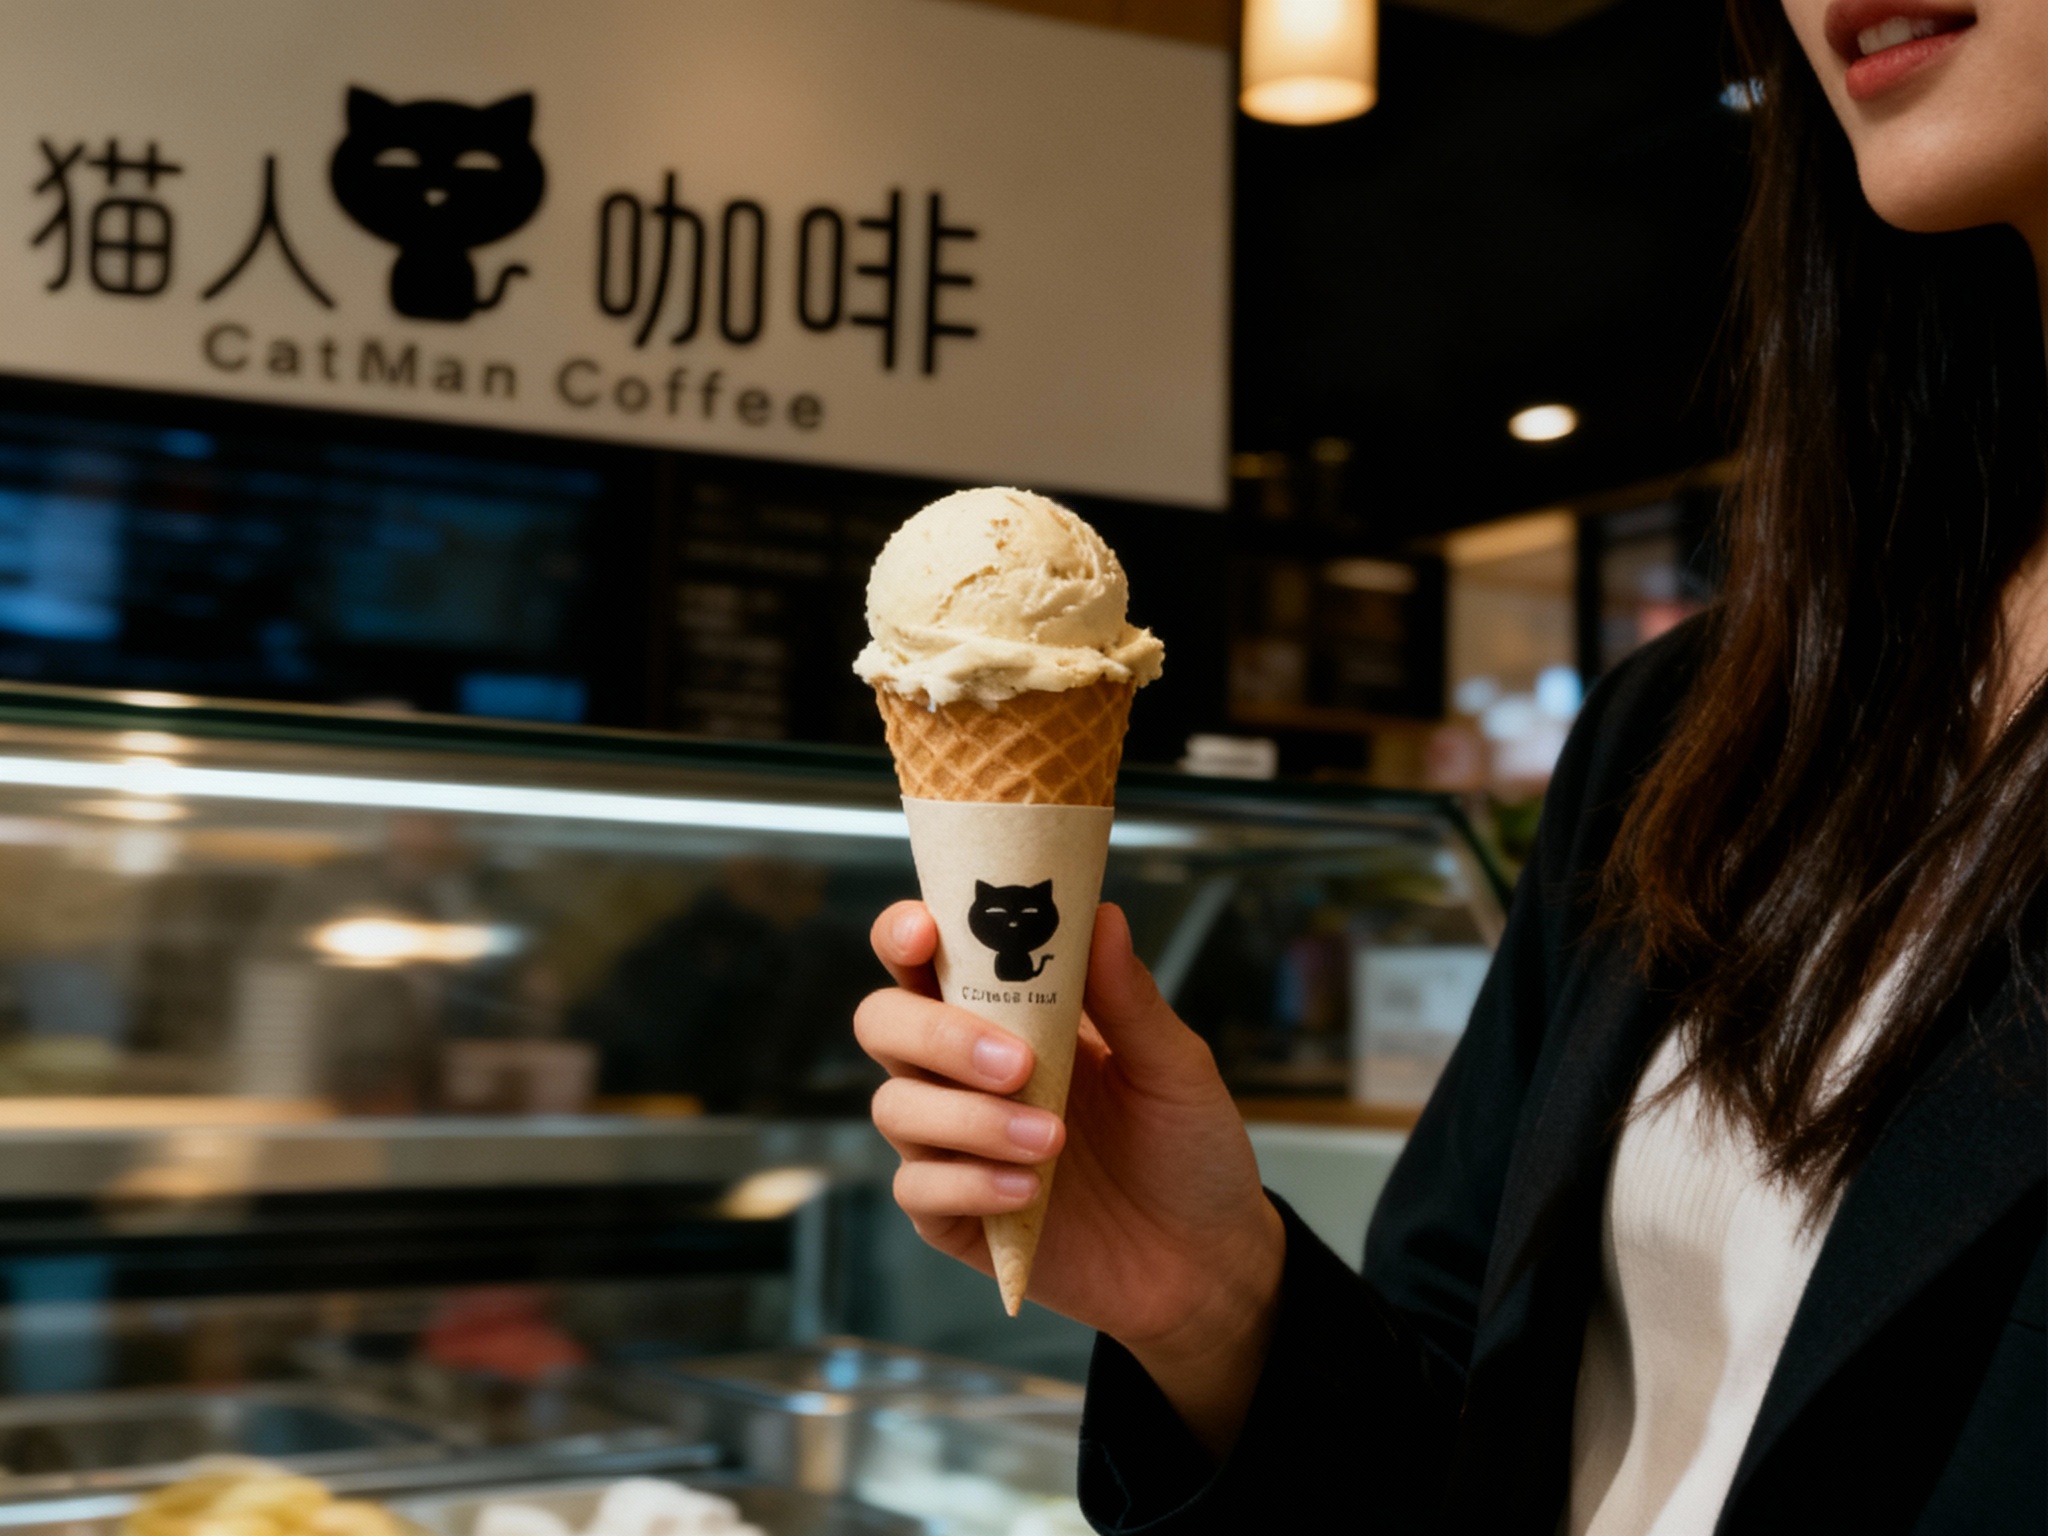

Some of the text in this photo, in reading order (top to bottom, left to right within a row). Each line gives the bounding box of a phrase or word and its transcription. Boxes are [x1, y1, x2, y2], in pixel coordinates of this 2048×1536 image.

[29, 137, 982, 381] 猫人 咖啡
[201, 322, 825, 433] CatMan Coffee
